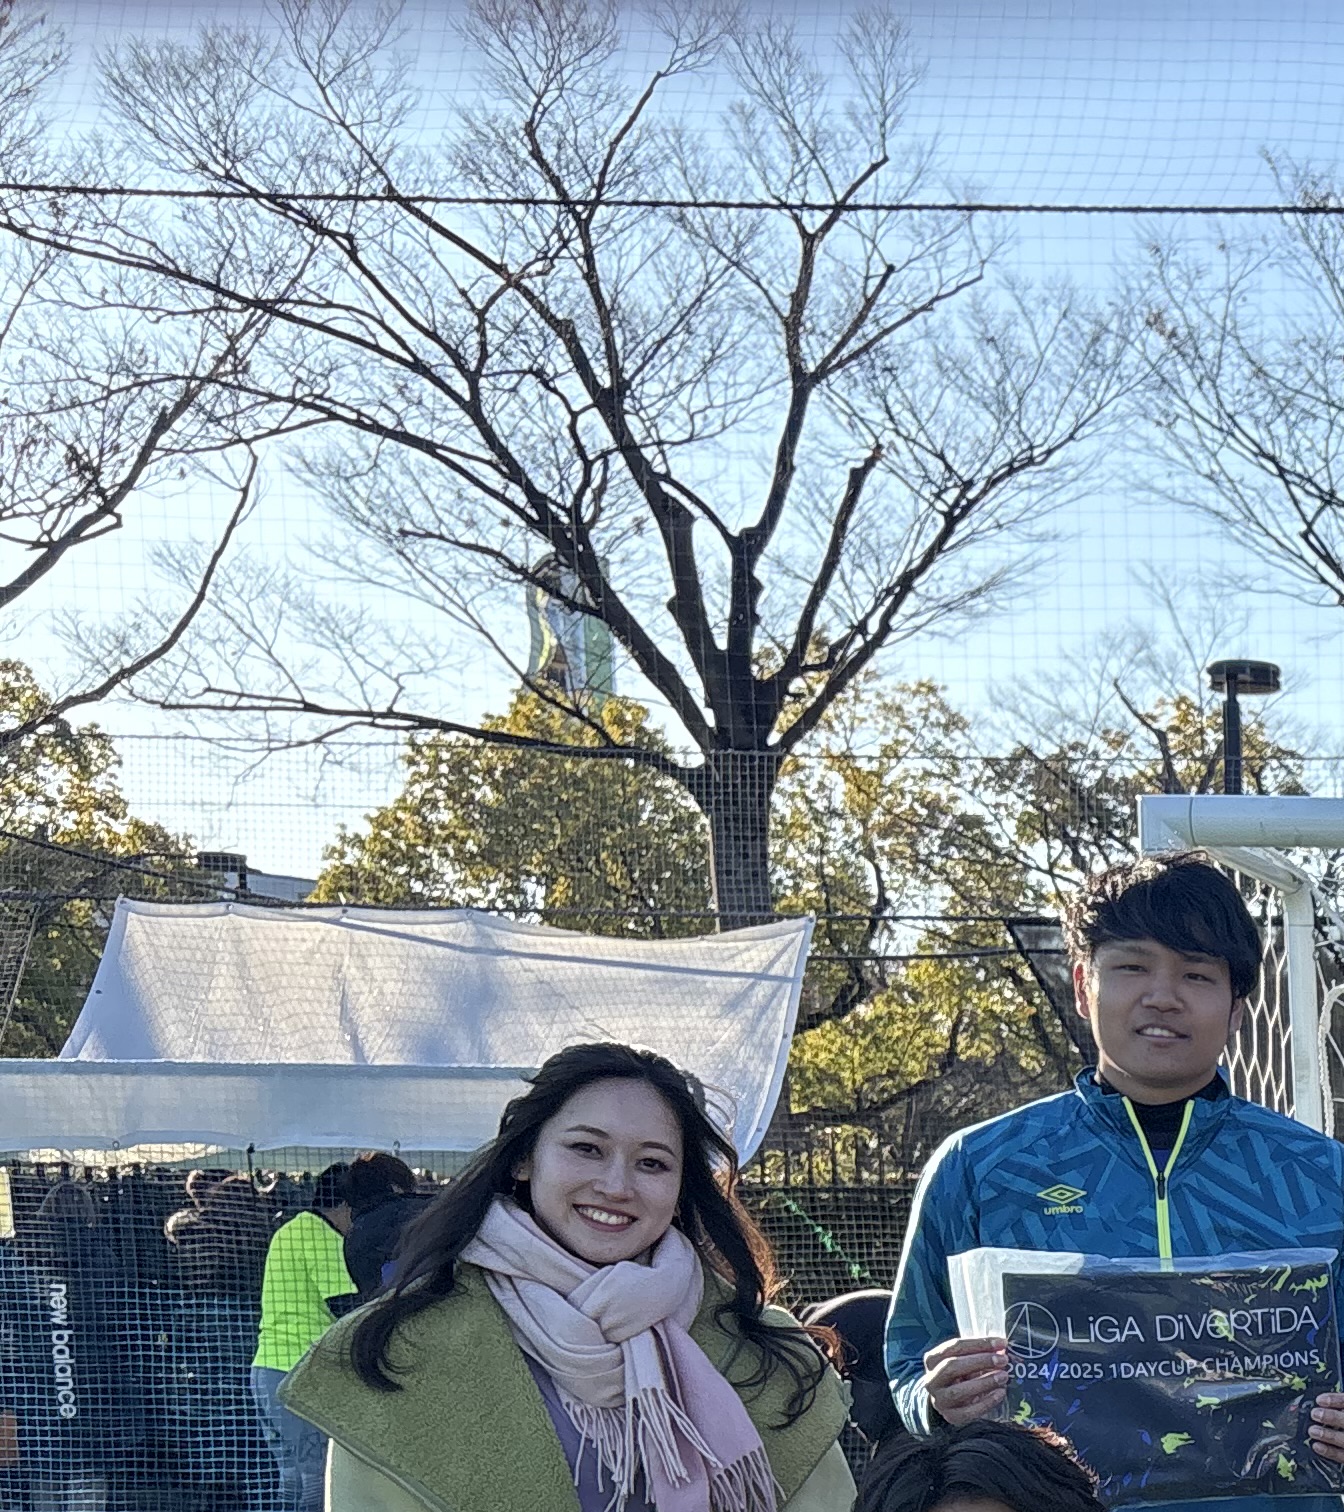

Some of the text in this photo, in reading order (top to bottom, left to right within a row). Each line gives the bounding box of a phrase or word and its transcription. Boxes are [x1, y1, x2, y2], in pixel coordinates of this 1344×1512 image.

[1043, 1204, 1084, 1216] umbro
[49, 1283, 77, 1420] new balance
[1007, 1349, 1320, 1382] 2024/2025 1DAYCUP CHAMPIONS
